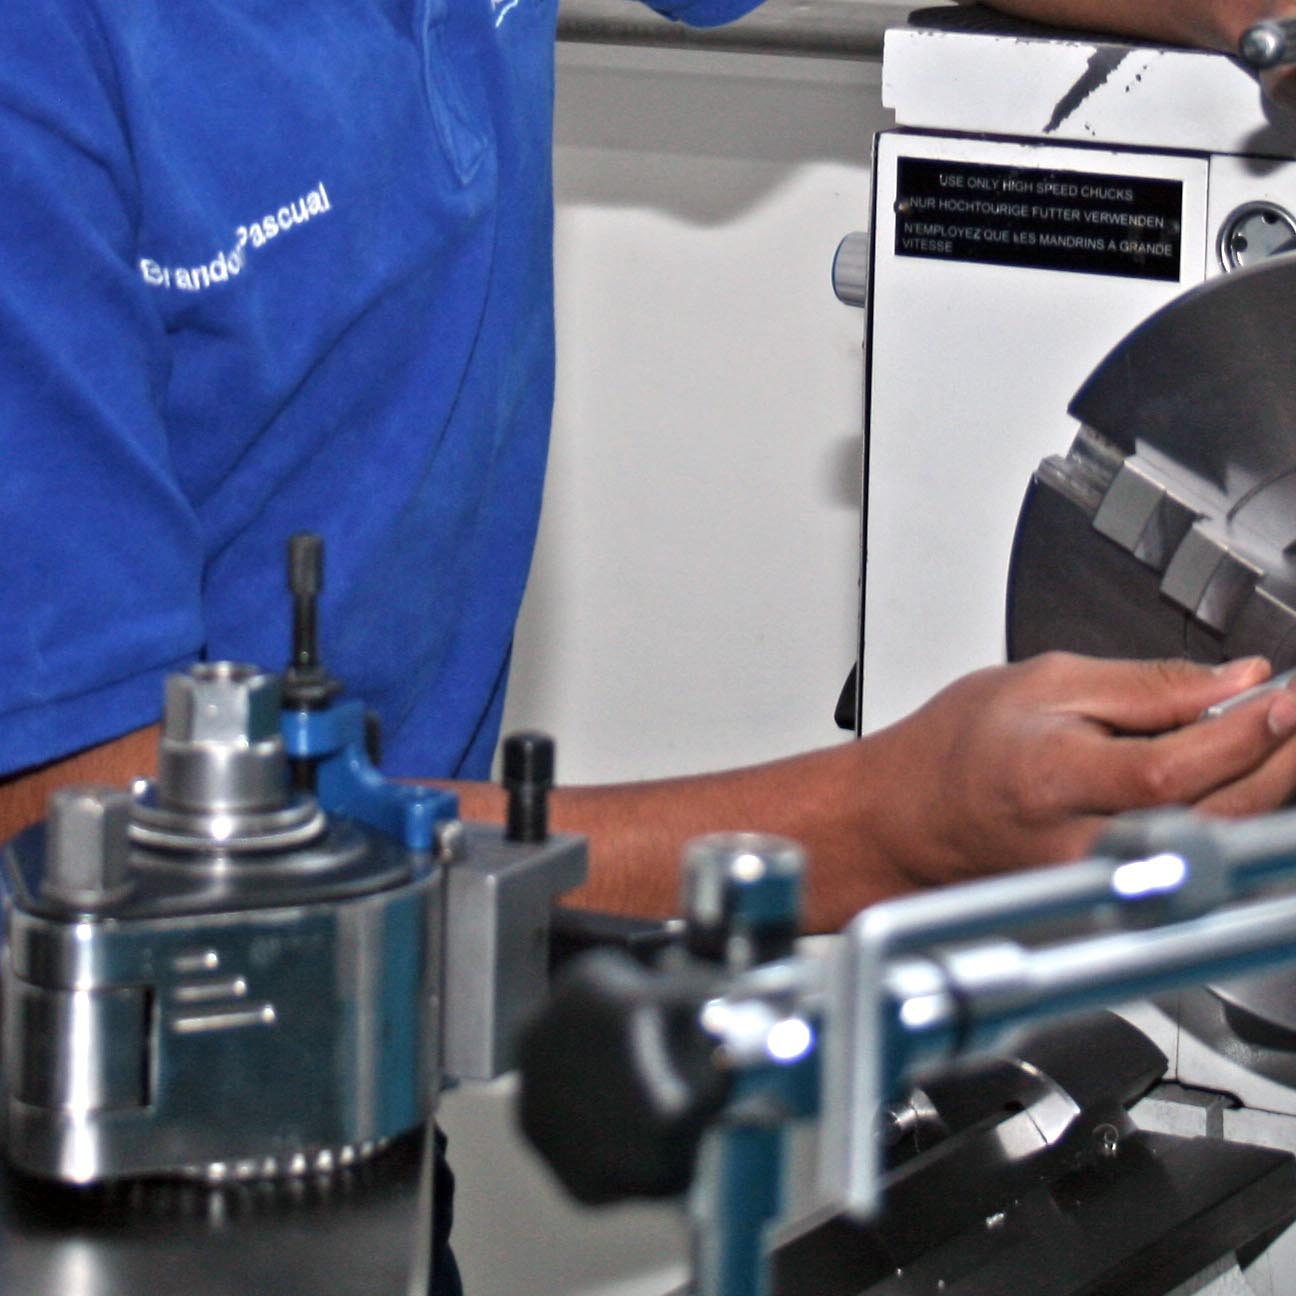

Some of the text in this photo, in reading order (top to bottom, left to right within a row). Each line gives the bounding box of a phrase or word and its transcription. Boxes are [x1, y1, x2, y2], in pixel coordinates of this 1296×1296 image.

[939, 174, 1134, 201] USE ONLY HIGH SPEED CHUCKS
[910, 197, 1165, 229] NUR HOCHTOURIGE FUTTER VERWENDEN
[902, 237, 953, 253] VITESSE
[984, 229, 1009, 242] QUE
[1013, 231, 1036, 244] LES
[1039, 233, 1104, 251] MANDRINS
[1119, 241, 1173, 257] GRANDE
